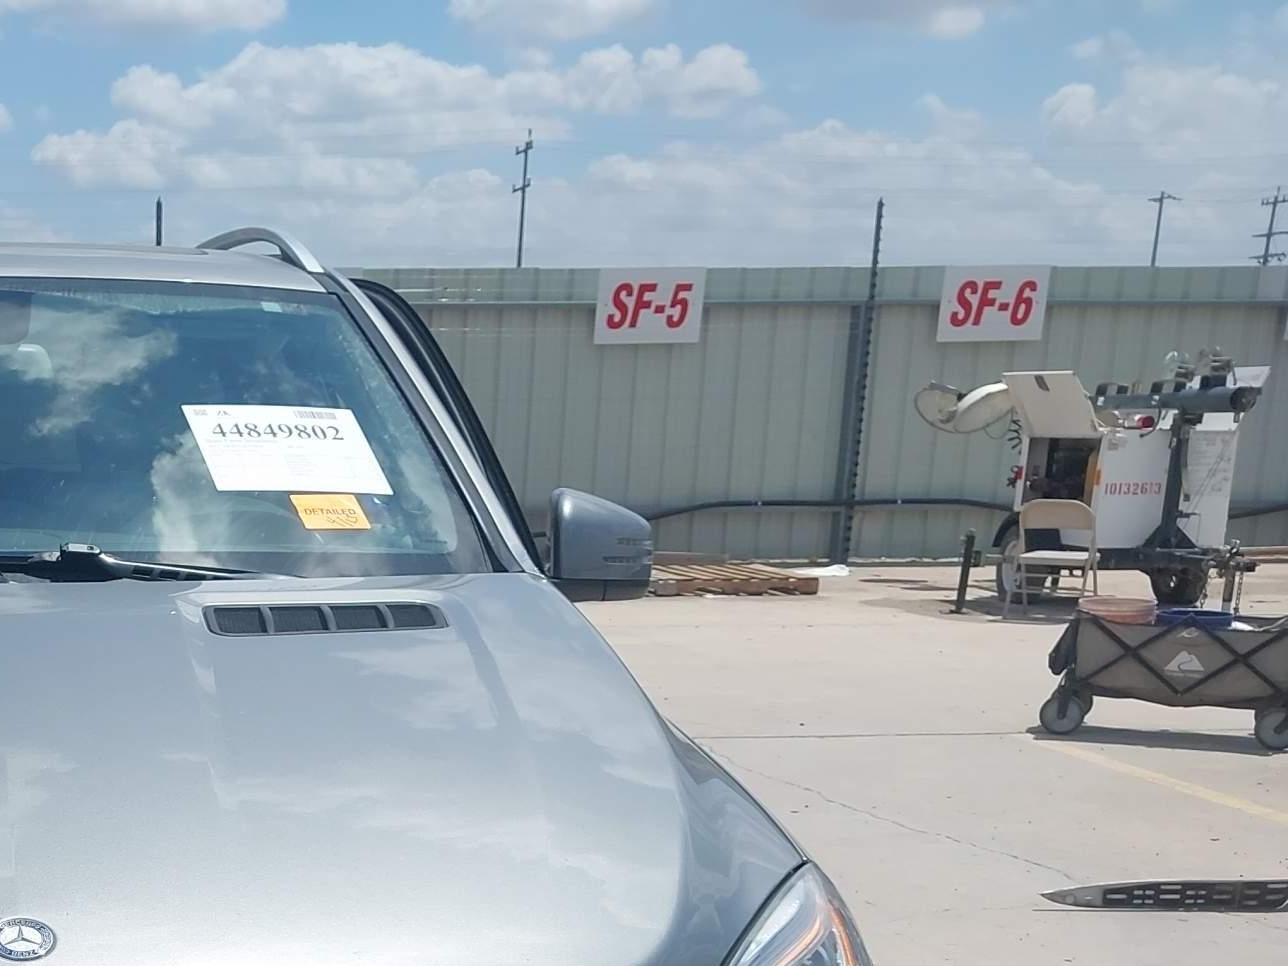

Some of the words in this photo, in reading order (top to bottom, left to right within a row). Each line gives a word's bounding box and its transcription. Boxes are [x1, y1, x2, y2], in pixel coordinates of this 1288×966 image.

[605, 281, 692, 331] SF-5
[949, 279, 1037, 327] SF-6
[212, 422, 345, 440] 44849802
